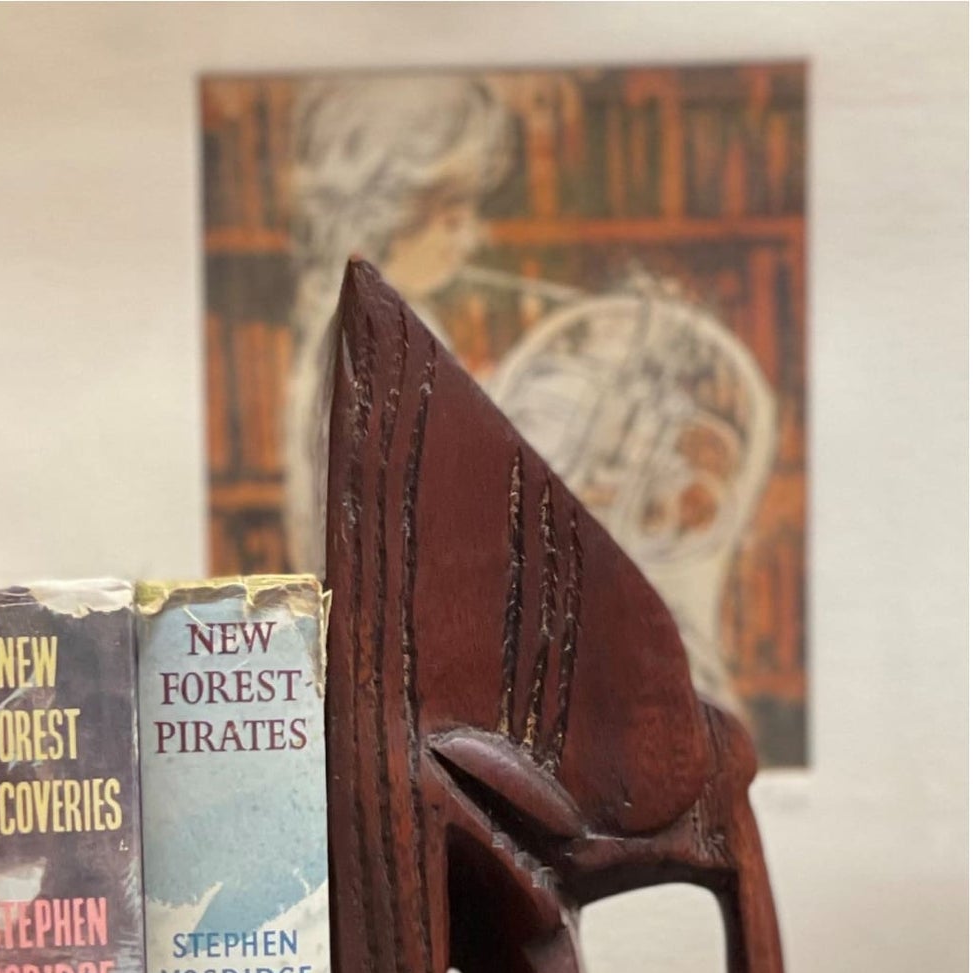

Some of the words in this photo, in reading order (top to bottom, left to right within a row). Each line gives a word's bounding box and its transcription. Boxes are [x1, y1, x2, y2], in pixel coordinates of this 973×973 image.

[186, 621, 277, 656] NEW
[160, 669, 302, 706] FOREST
[154, 718, 308, 754] PIRATES
[172, 930, 298, 959] STEPHEN
